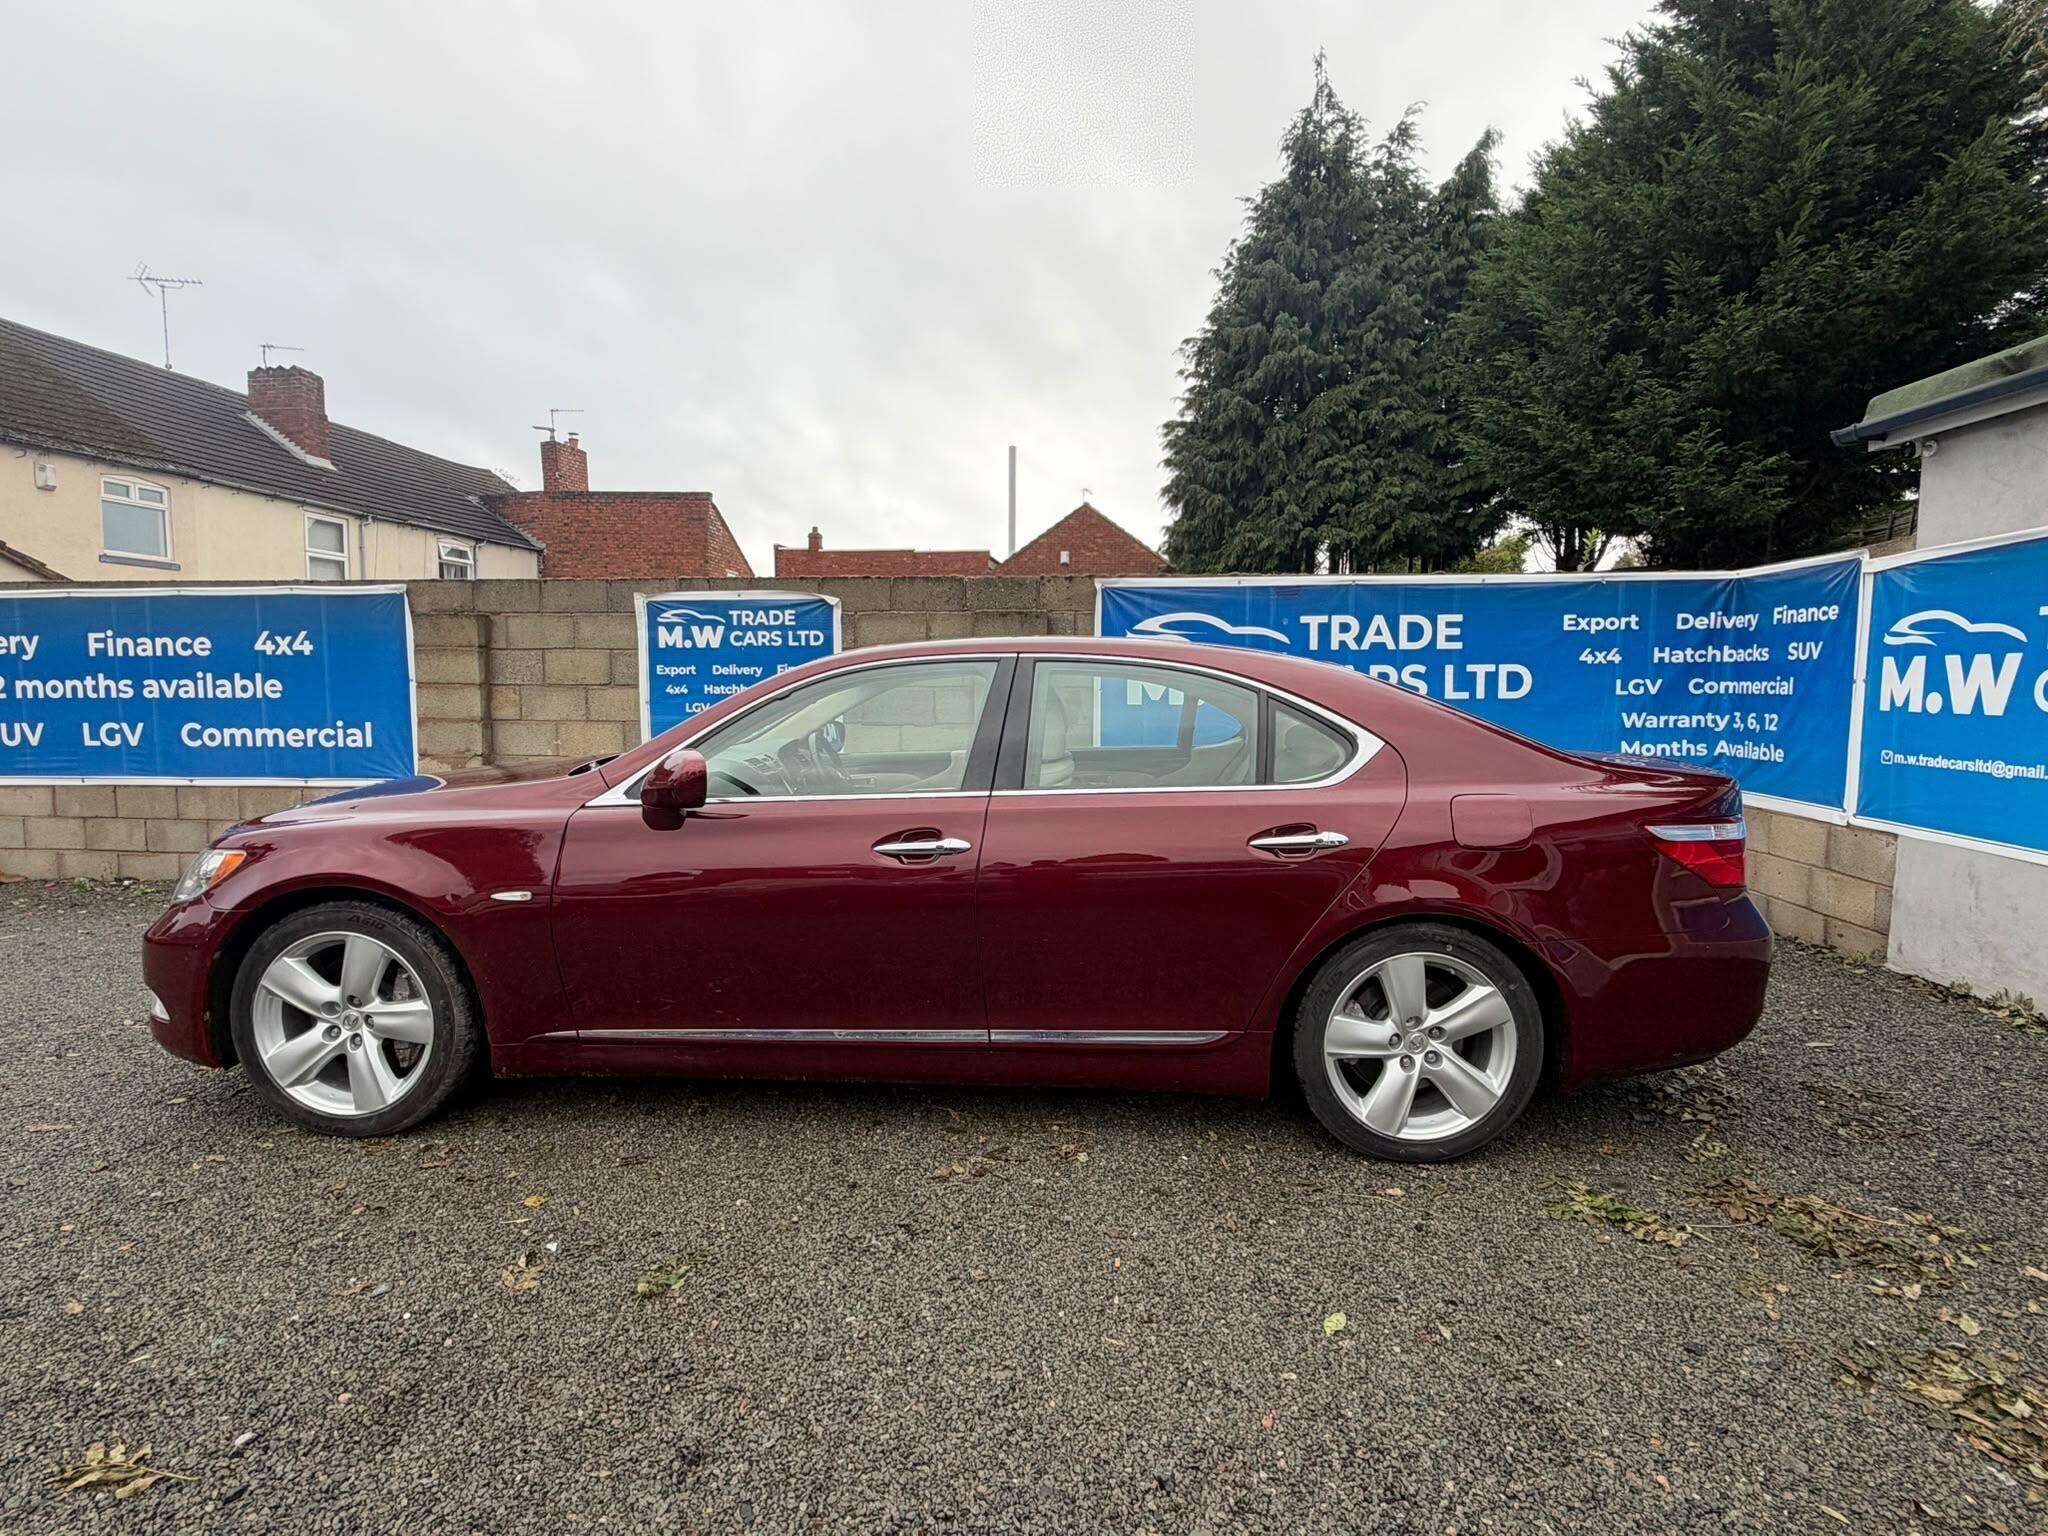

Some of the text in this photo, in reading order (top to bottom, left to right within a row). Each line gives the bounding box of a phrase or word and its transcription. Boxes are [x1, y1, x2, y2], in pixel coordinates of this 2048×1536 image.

[729, 610, 795, 625] TRADE
[1564, 606, 1838, 633] Export Delivery Finance
[88, 630, 211, 656] Finance
[255, 631, 313, 655] 4x4
[658, 626, 824, 648] M.W CARS LTD
[1300, 614, 1463, 650] TRADE
[1580, 642, 1822, 663] 4x4 Hatchbacks SUV
[657, 665, 696, 677] Export
[713, 664, 762, 676] Delivery
[1445, 664, 1532, 699] LTD
[16, 673, 133, 698] months
[143, 672, 282, 698] available
[666, 685, 688, 694] 4x4
[1616, 677, 1793, 695] LGV Commercial
[1880, 653, 2022, 715] M.W
[1622, 713, 1729, 731] Warranty
[1765, 714, 1778, 730] 12
[83, 723, 143, 746] LGV
[182, 721, 372, 747] Commercial
[1620, 740, 1784, 762] Months Available
